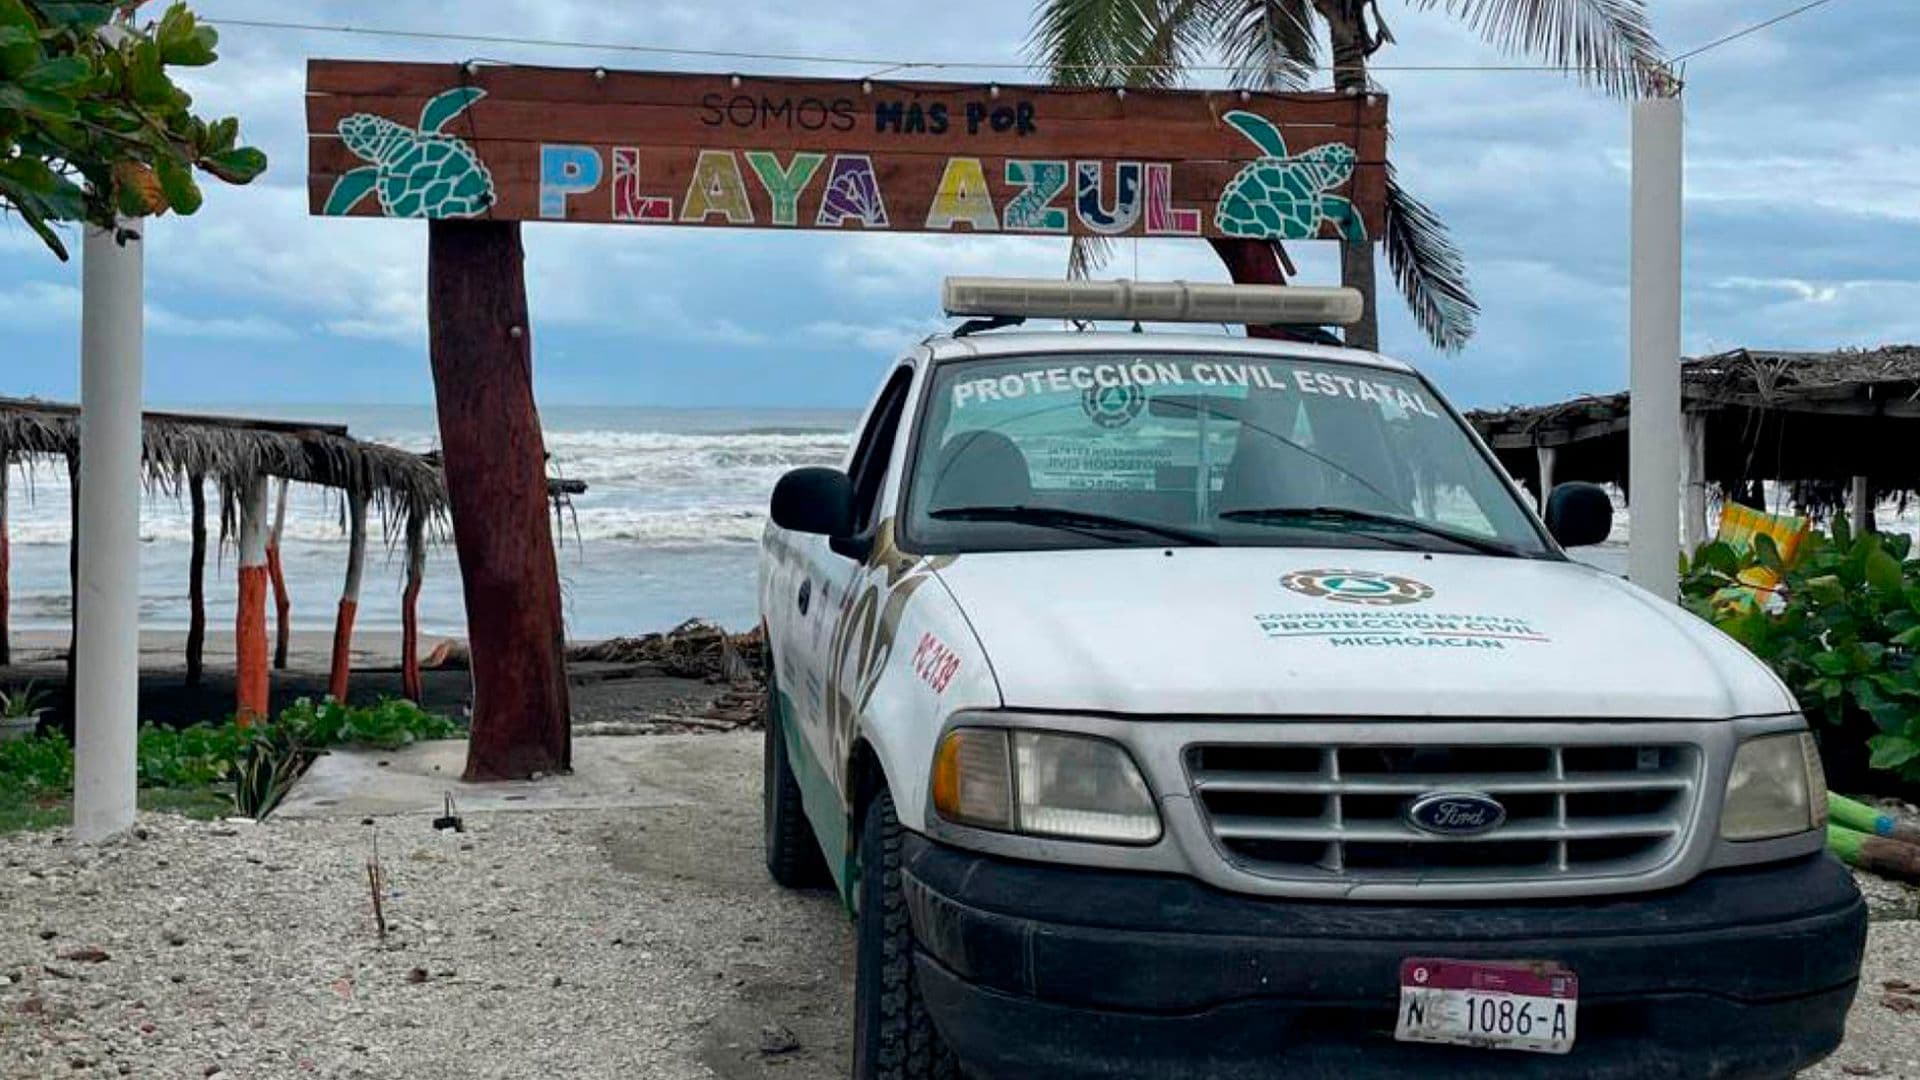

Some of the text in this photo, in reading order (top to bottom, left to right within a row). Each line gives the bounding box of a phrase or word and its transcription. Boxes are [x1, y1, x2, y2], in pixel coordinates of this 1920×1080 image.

[701, 92, 1036, 137] SOMOS MÁS POR
[539, 143, 1202, 236] PLAYA AZUL
[953, 358, 1441, 419] PROTECCIÓN CIVIL ESTATAL
[1464, 623, 1543, 635] CIVIL
[1434, 801, 1486, 825] Ford
[1466, 996, 1568, 1040] 1086-A
